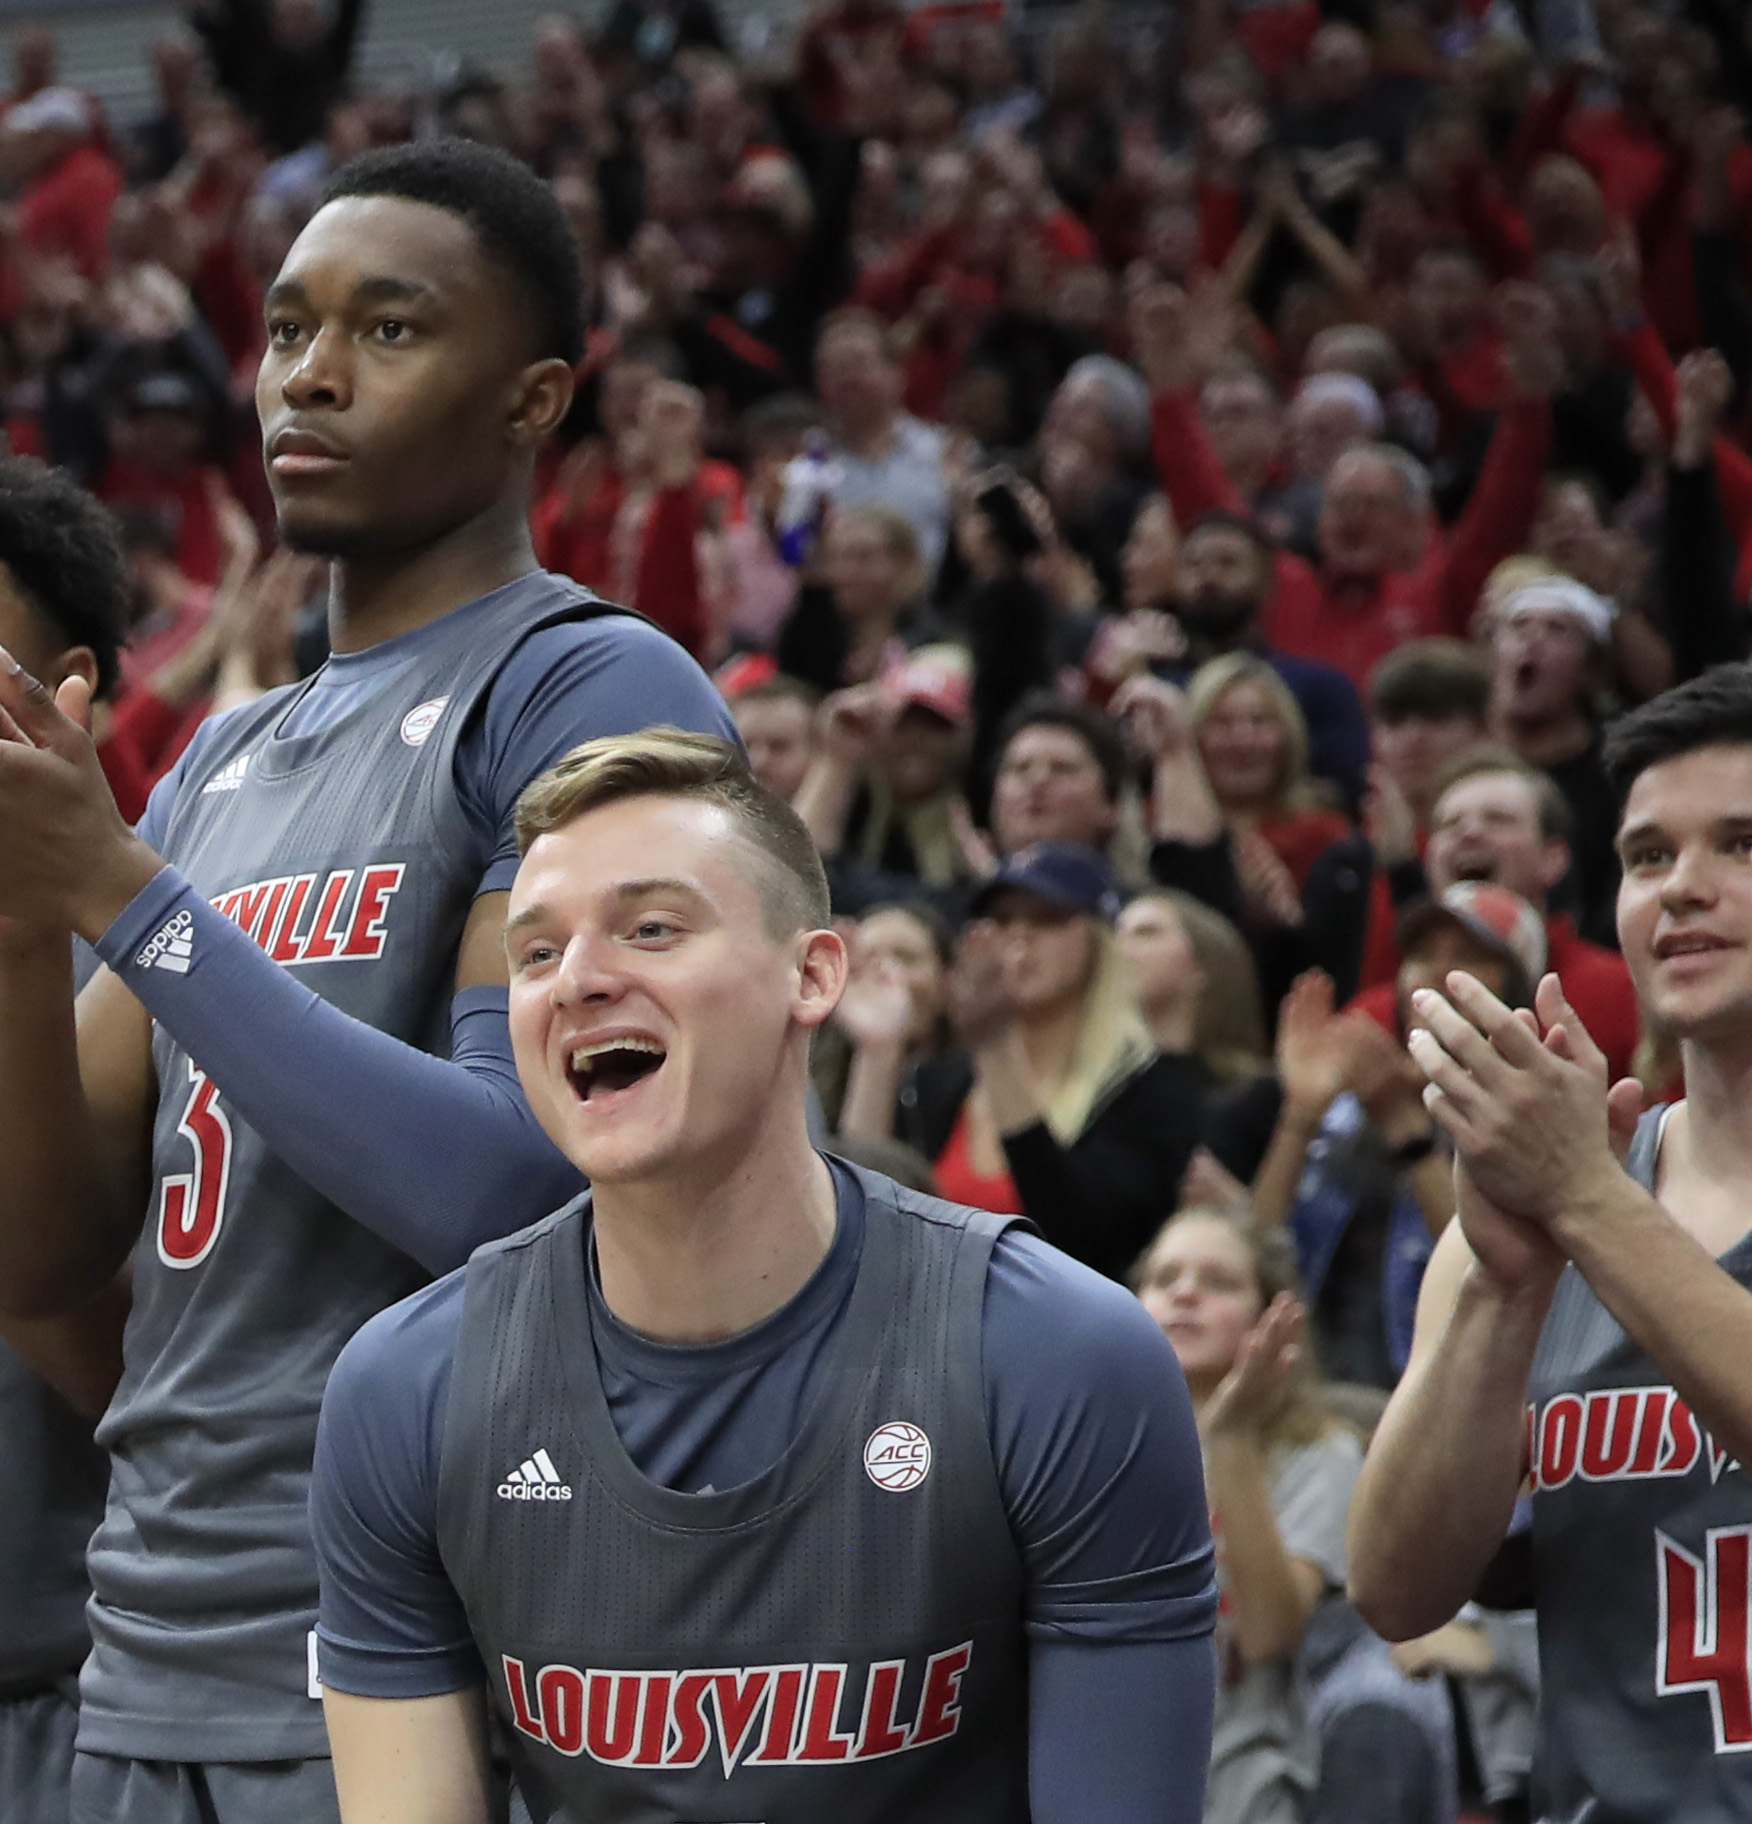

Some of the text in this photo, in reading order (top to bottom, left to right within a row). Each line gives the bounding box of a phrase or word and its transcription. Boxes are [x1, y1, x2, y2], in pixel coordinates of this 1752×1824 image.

[136, 908, 194, 969] adidas
[872, 1442, 927, 1461] ACC
[497, 1480, 573, 1502] adidas
[501, 1640, 974, 1782] LOUISVILLE
